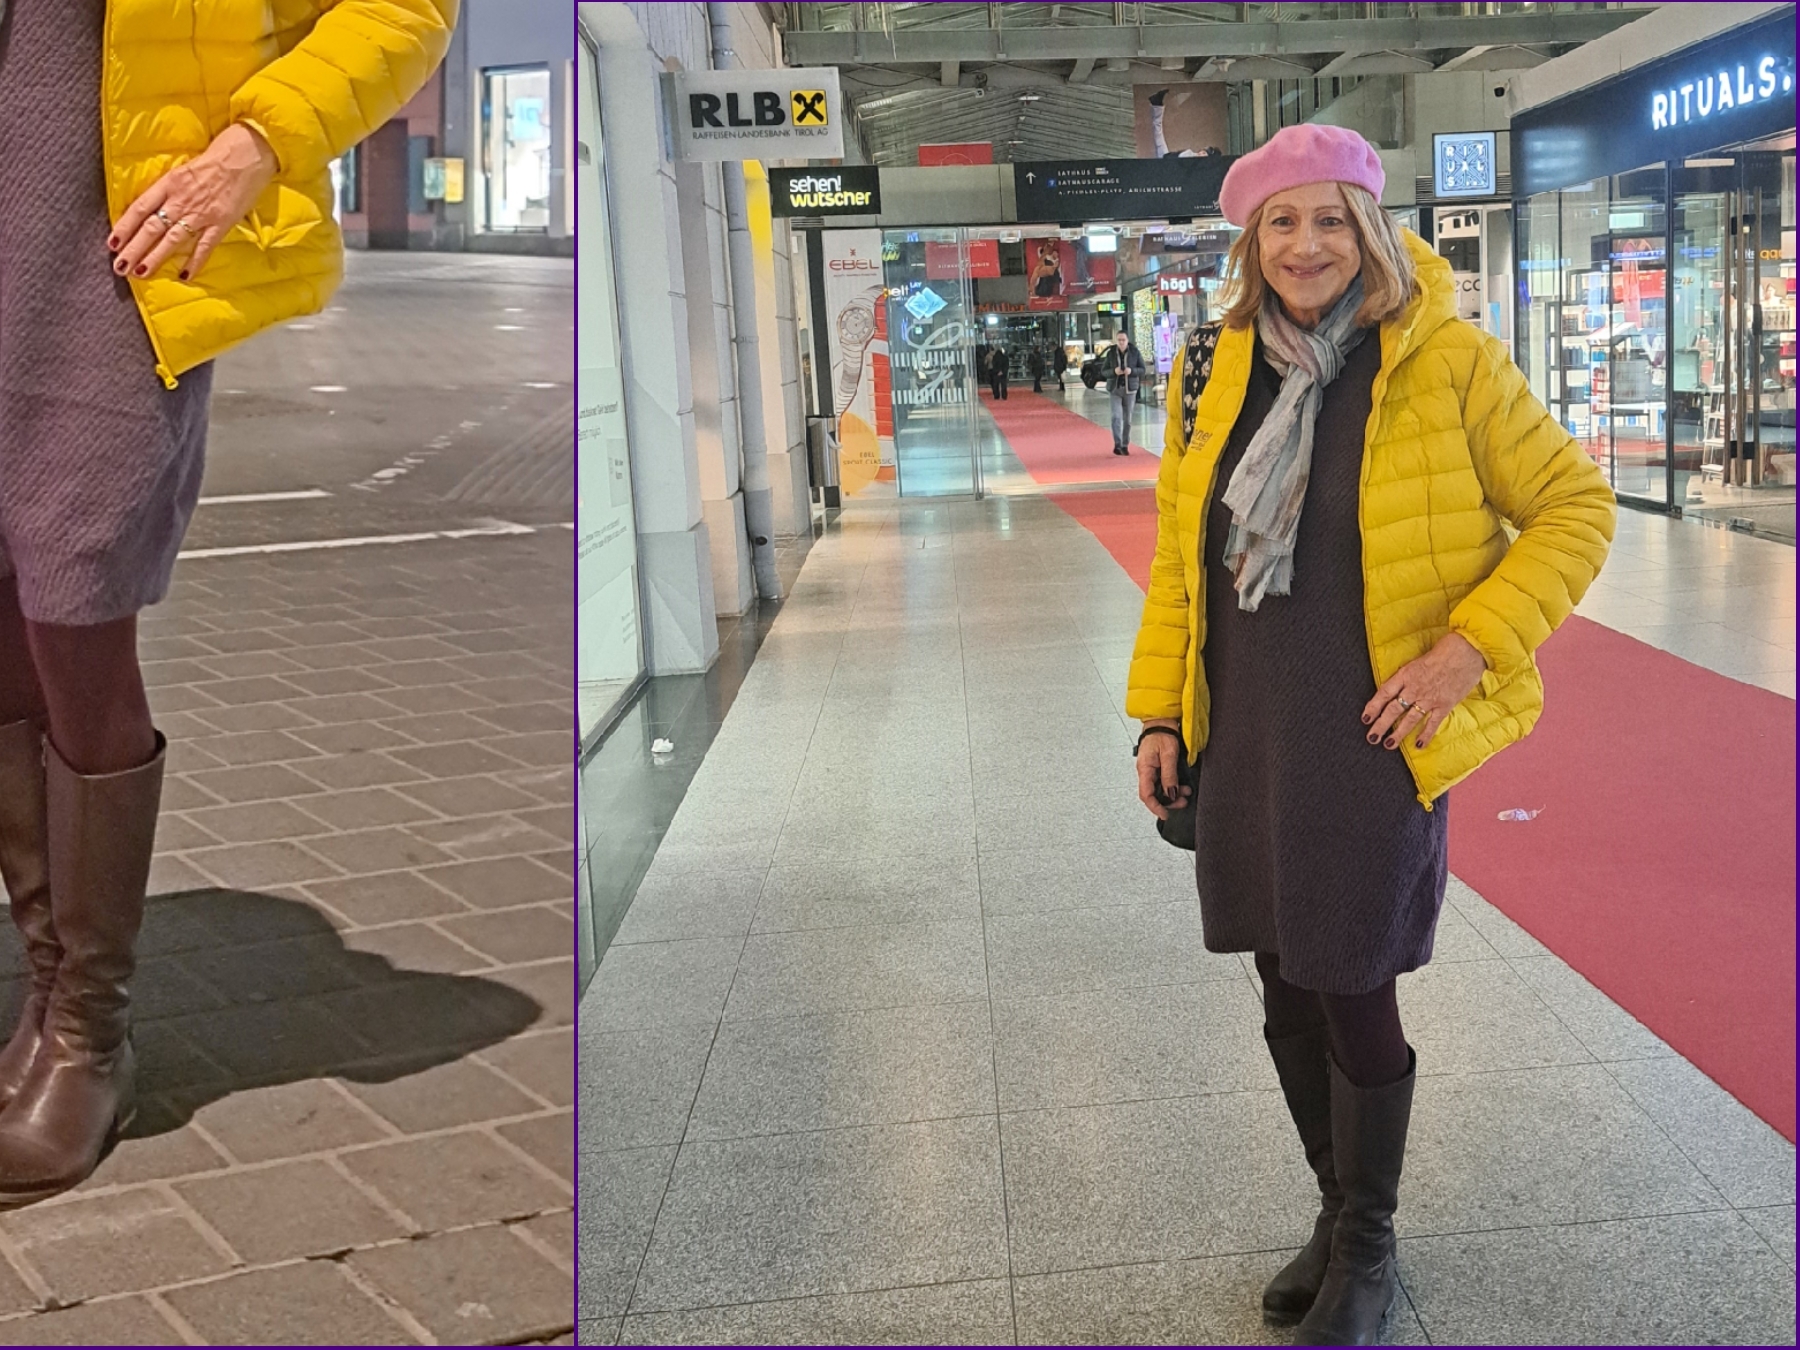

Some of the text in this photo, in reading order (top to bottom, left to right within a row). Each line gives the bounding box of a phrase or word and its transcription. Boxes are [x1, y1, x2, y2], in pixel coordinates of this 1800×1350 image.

[689, 91, 786, 128] RLB
[794, 128, 815, 137] TIROL
[817, 127, 829, 136] AG
[789, 175, 842, 193] sehen!
[789, 191, 872, 208] wutscher
[829, 258, 880, 271] EBEL
[865, 457, 893, 465] CLASSIC
